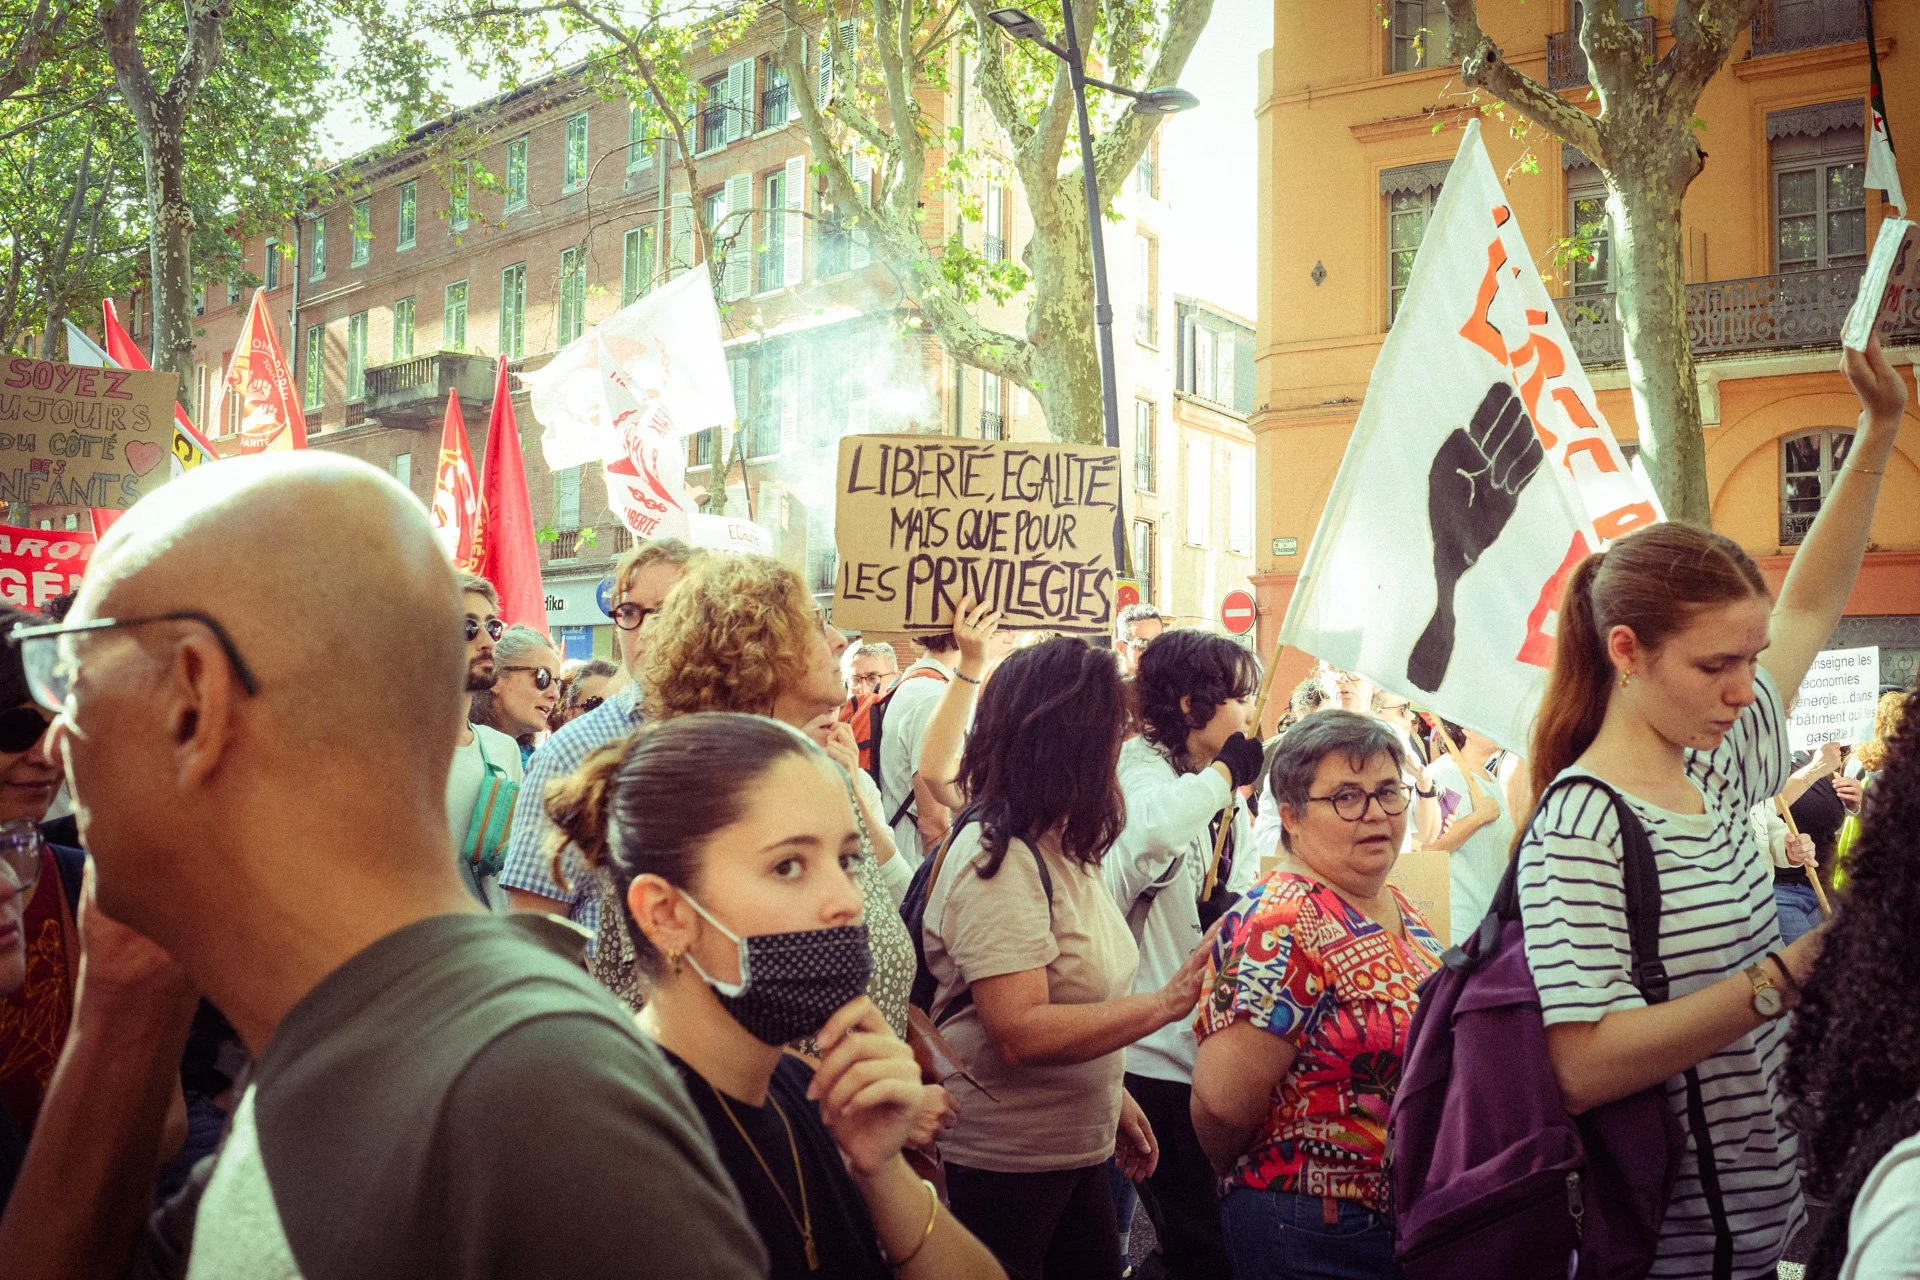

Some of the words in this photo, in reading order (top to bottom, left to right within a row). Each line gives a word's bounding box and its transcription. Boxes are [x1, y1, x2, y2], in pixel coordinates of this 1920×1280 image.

[4, 358, 133, 400] SOYEZ
[0, 432, 36, 452] DU
[50, 429, 118, 461] CÔTÉ
[29, 458, 67, 475] DES
[890, 505, 951, 551] MAIS
[956, 508, 1011, 552] QUE
[1014, 509, 1077, 555] POUR
[0, 562, 83, 608] GÉ
[843, 560, 900, 601] LES
[904, 552, 1114, 623] PRIVILÉGIÉS
[1858, 654, 1873, 666] les
[1796, 711, 1846, 726] bâtiment
